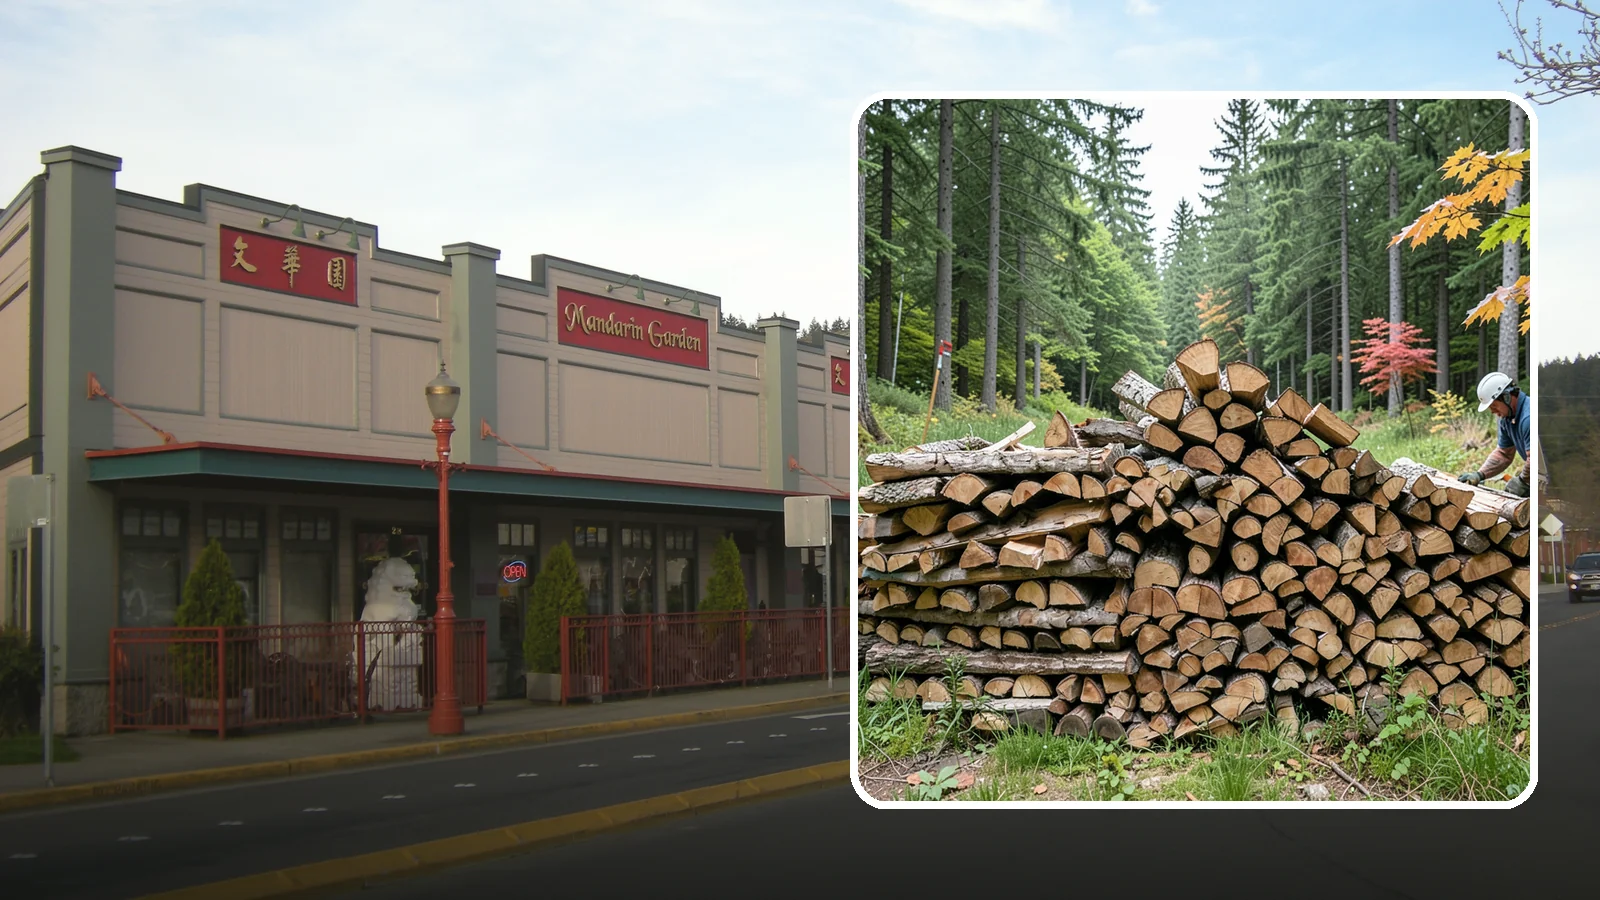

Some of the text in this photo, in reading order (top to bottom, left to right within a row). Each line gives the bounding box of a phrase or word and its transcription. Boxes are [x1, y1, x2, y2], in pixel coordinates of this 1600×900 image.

[231, 236, 346, 291] 文華園
[565, 302, 701, 351] Mandarin Garden
[503, 565, 527, 578] OPEN
